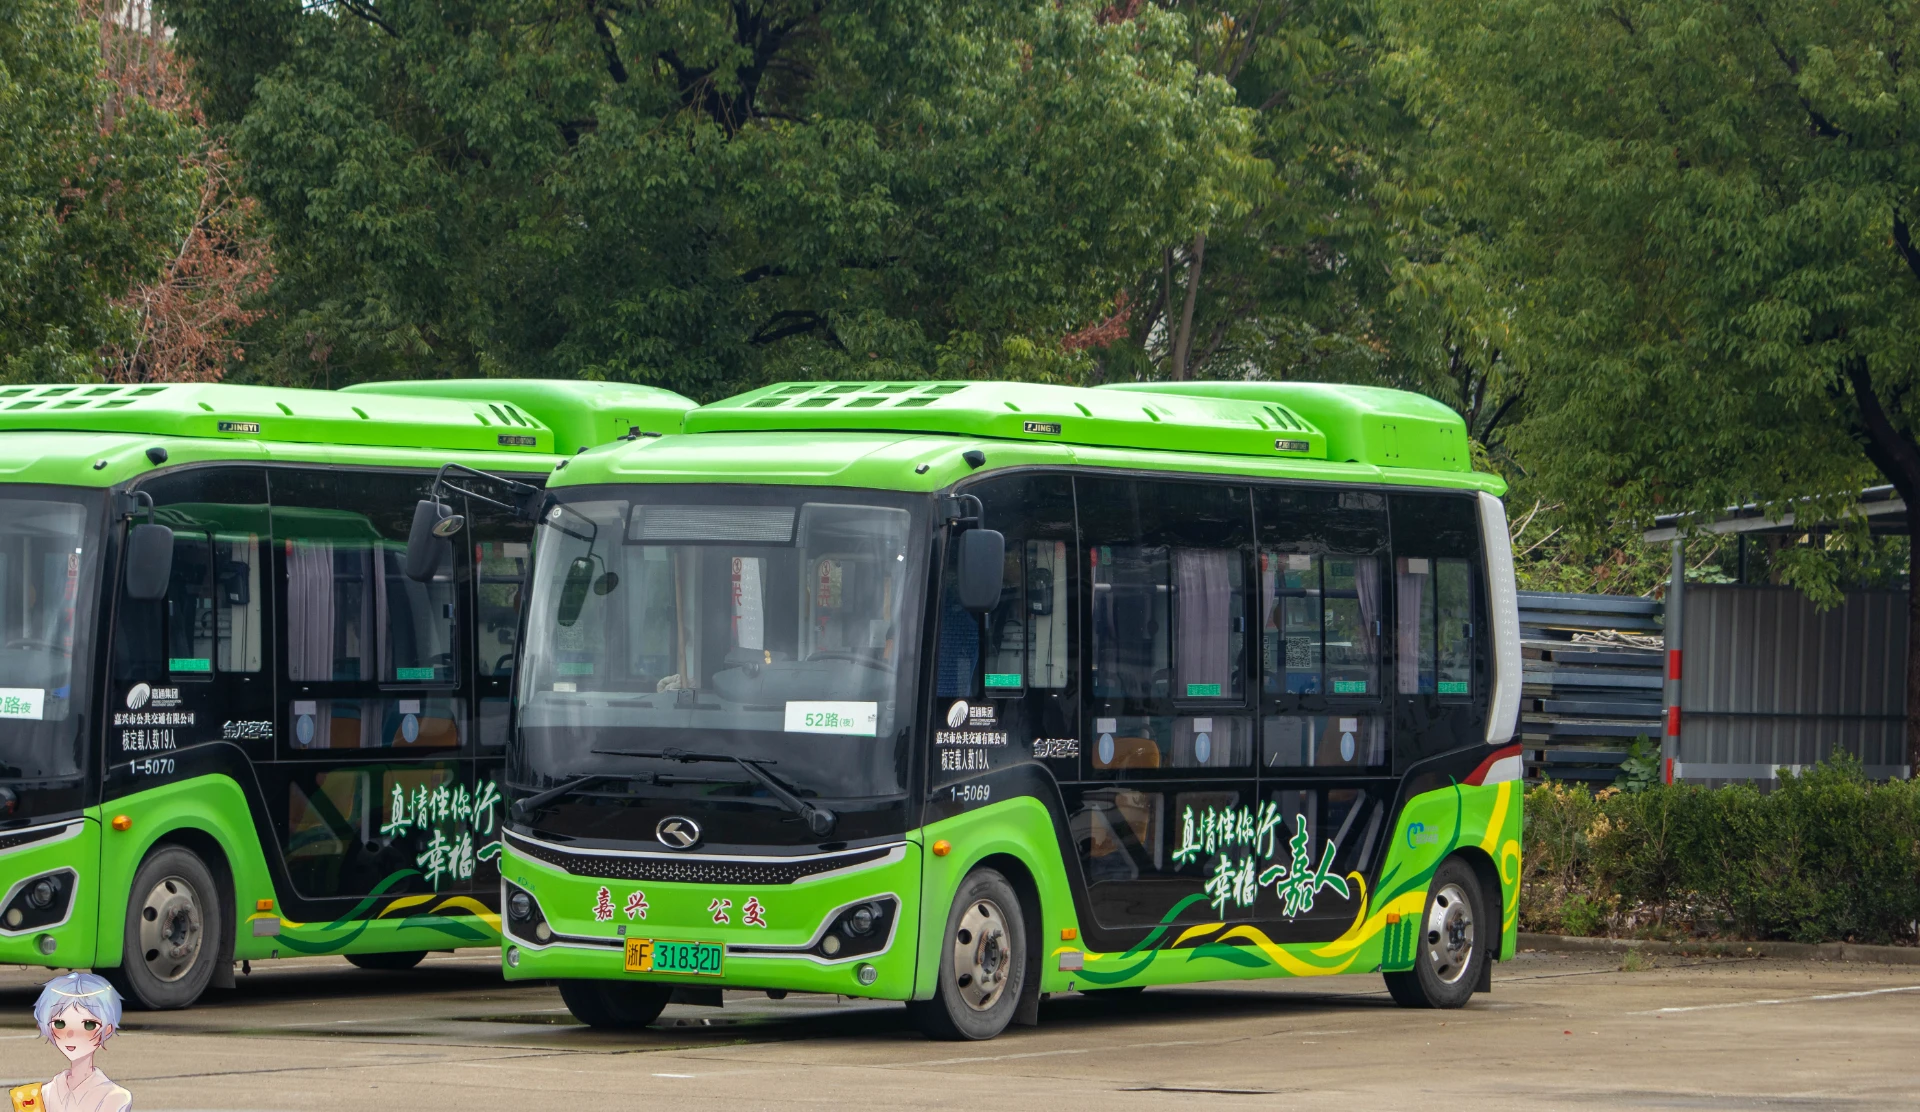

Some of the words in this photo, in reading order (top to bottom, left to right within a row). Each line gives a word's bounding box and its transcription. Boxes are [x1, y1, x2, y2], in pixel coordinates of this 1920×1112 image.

[229, 424, 257, 432] JINGYI
[151, 688, 179, 700] 嘉通集团
[114, 712, 194, 725] 嘉兴市公共交通有限公司
[805, 712, 854, 728] 52路(夜)
[122, 729, 176, 751] 核定载人数19人
[222, 720, 273, 740] 金龙客车
[936, 731, 1007, 745] 嘉兴市公共交通有限公司
[129, 759, 175, 775] 1-5070
[941, 748, 990, 771] 核定载人数19人
[950, 784, 990, 802] 1-5069
[380, 779, 502, 838] 真情伴你行
[1172, 800, 1282, 865] 真情伴你行
[416, 828, 502, 892] 幸福一
[1204, 813, 1350, 920] 幸福一嘉人
[592, 885, 650, 922] 嘉兴
[707, 895, 767, 929] 公交
[628, 943, 650, 967] 浙F
[657, 944, 721, 971] 31832D
